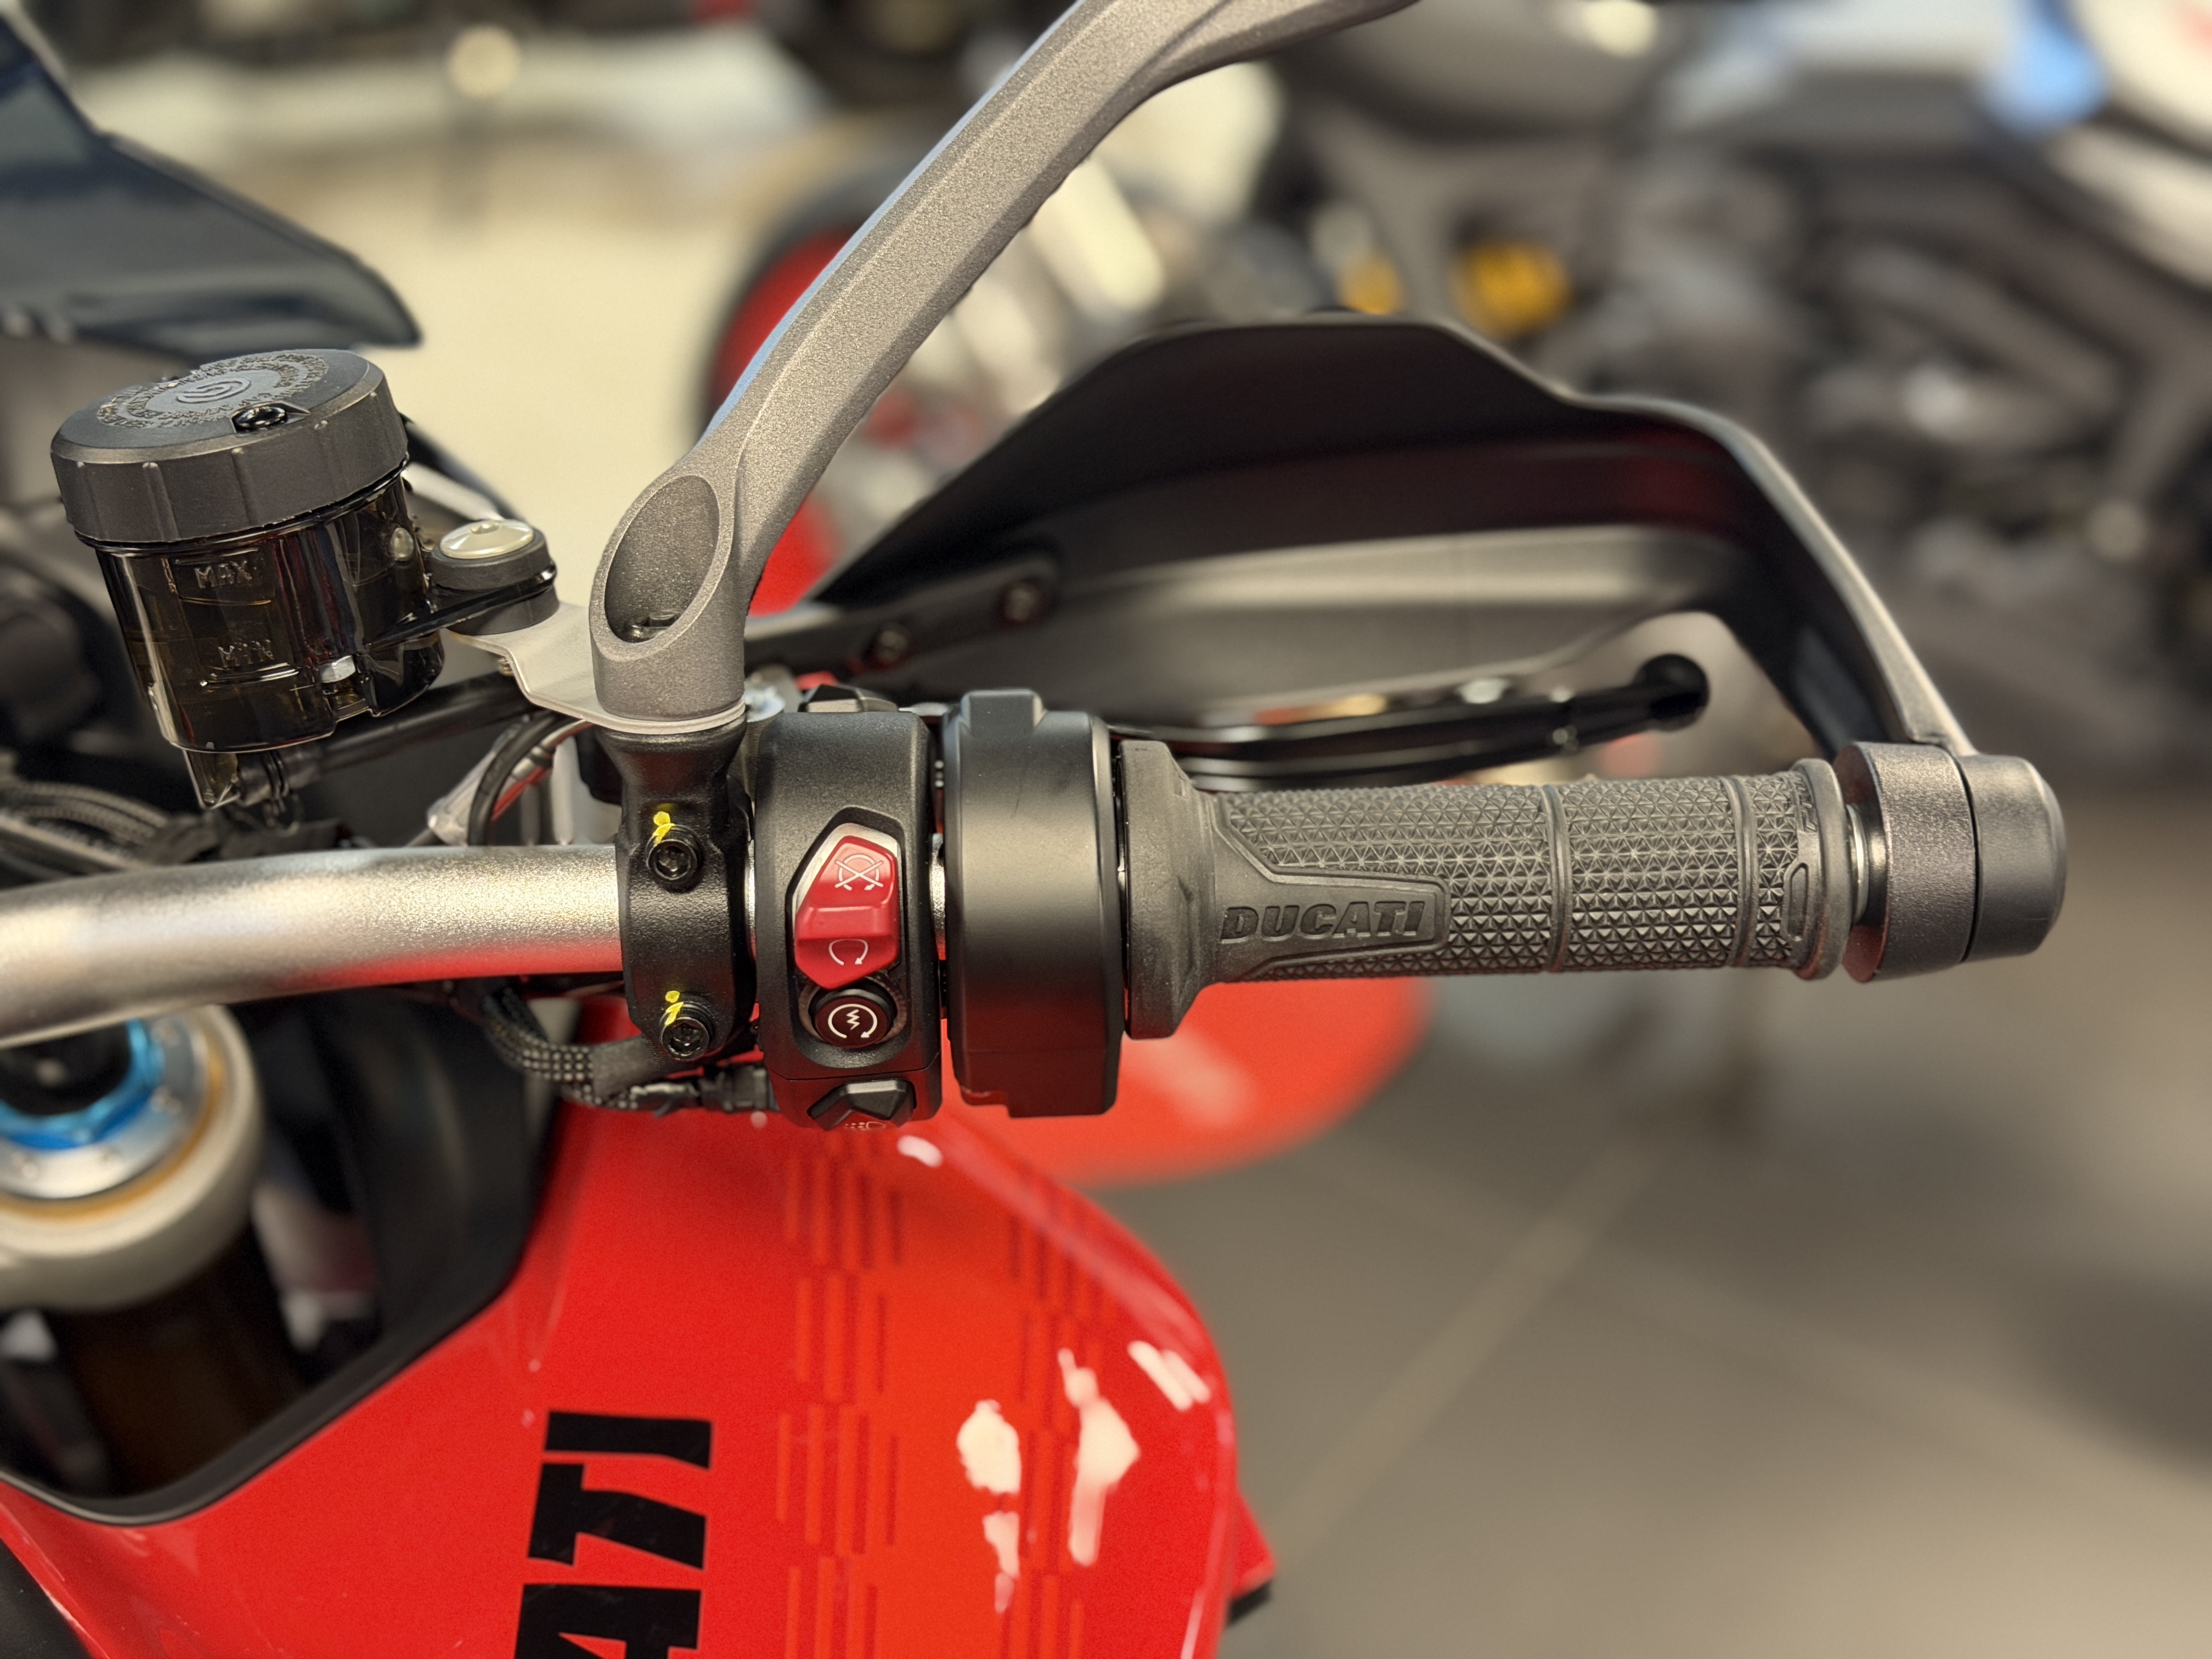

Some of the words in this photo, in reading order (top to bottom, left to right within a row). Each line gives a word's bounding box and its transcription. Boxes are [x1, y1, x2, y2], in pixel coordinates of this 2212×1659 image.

[194, 561, 253, 589] MAX
[218, 639, 274, 668] MIN
[1220, 900, 1426, 944] DUCATI
